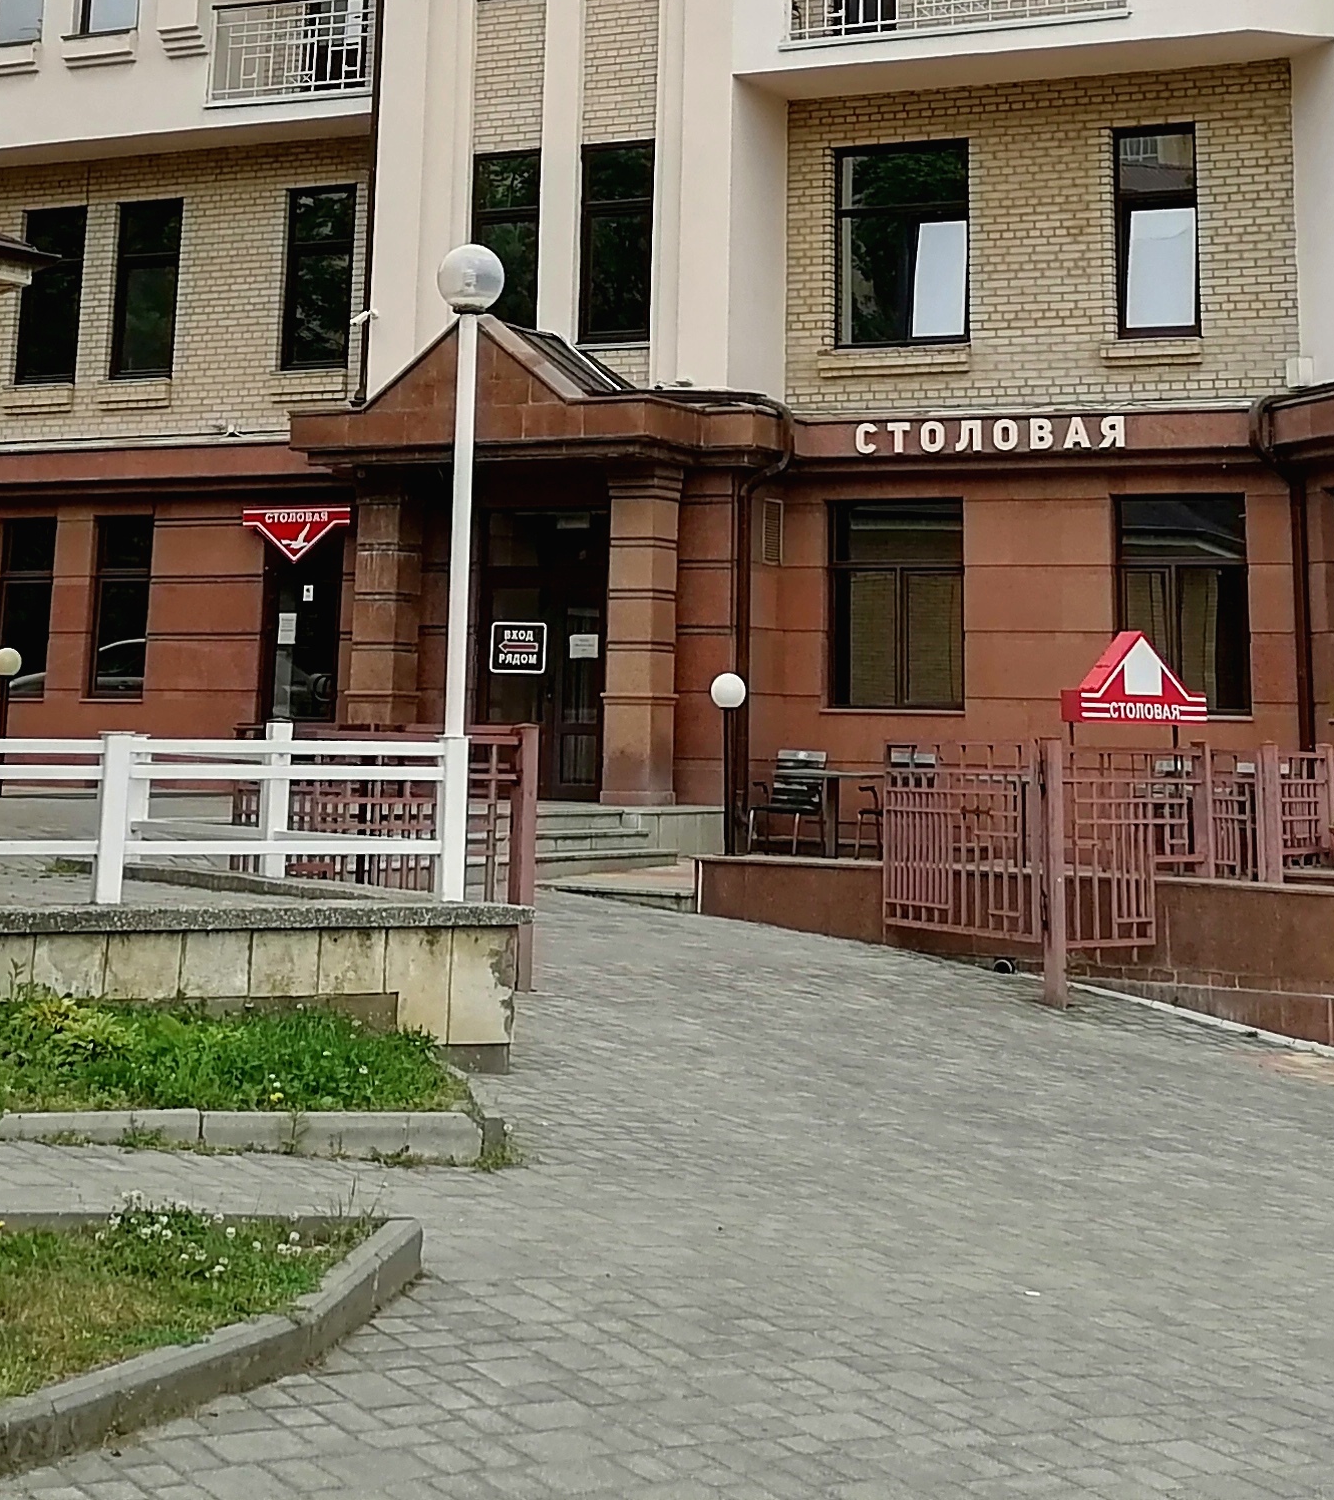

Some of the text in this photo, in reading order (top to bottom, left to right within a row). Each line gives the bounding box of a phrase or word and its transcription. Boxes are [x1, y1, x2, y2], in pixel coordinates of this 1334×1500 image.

[855, 415, 1126, 455] СТОЛОВАЯ
[265, 511, 328, 523] СТОЛОВАЯ
[504, 630, 534, 641] ВХОД
[498, 653, 537, 665] РЯДОМ
[1108, 702, 1181, 720] СТОЛОВАЯ
